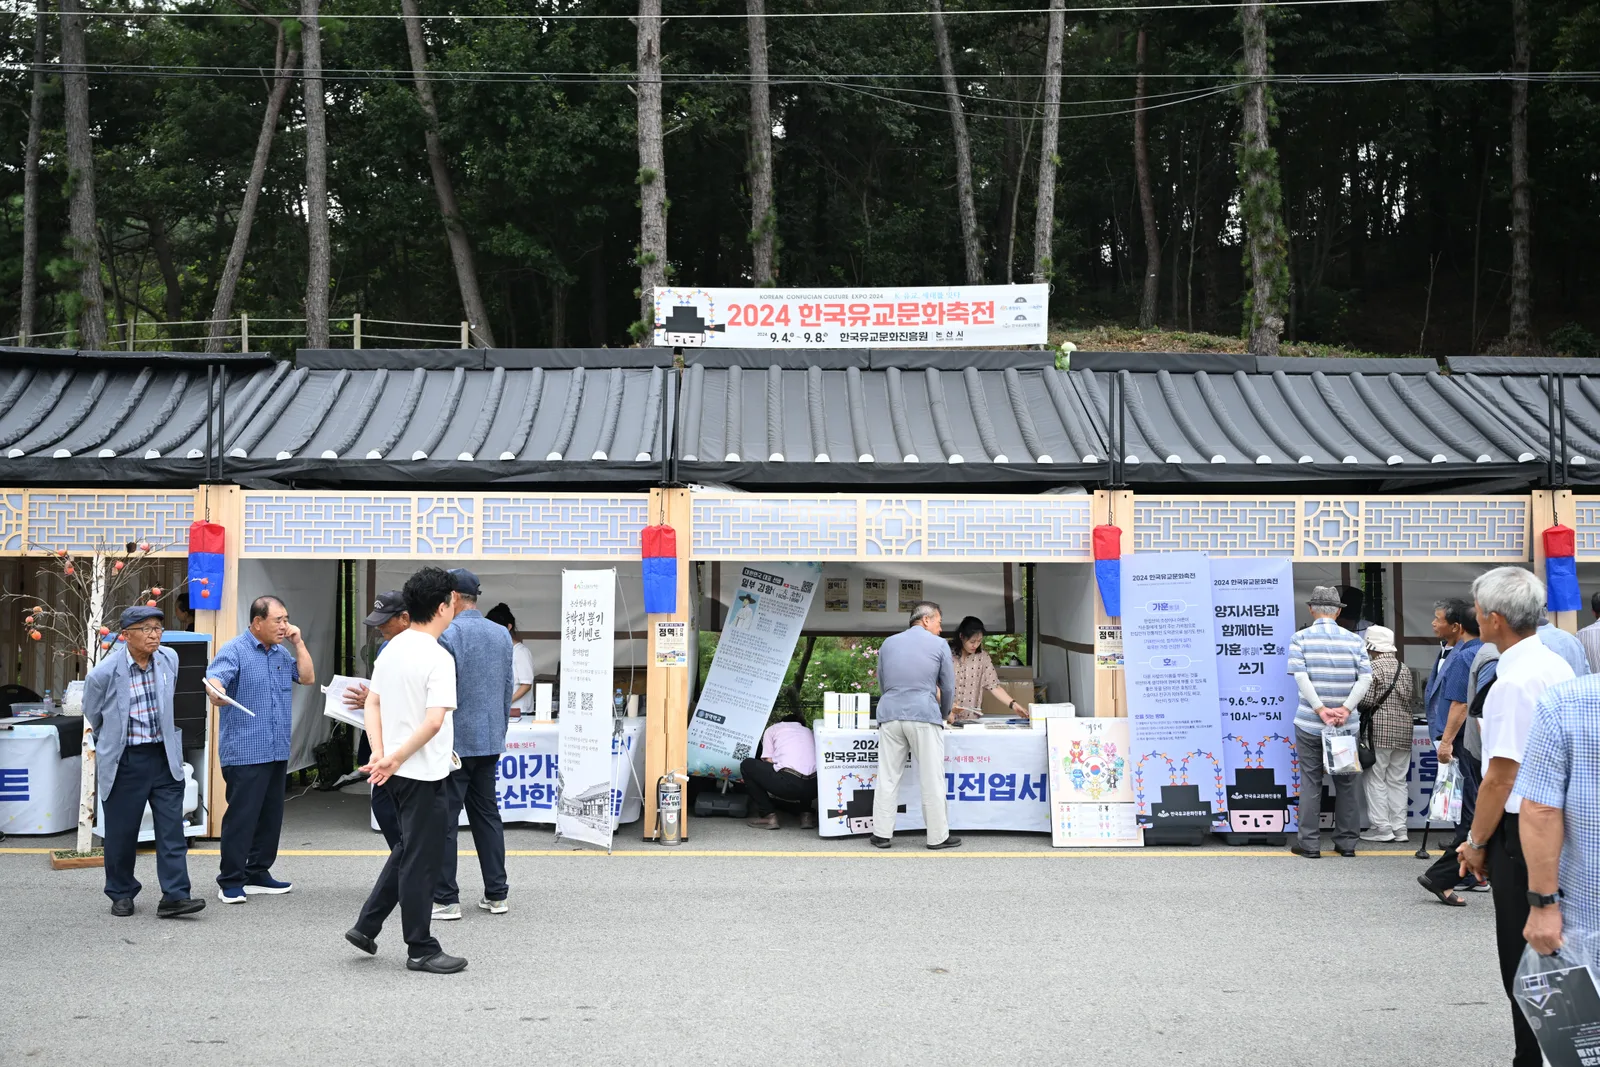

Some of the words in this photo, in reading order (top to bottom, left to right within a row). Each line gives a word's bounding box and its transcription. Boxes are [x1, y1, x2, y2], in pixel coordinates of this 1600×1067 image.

[728, 304, 791, 327] 2024
[798, 301, 994, 327] 한국유교문화축전
[840, 332, 928, 342] 한국유교문화진흥원
[1214, 604, 1279, 618] 양지서당과
[587, 611, 603, 626] 뽑기
[579, 628, 602, 642] 이벤트
[659, 628, 674, 637] 정역
[1100, 631, 1114, 639] 정역
[1221, 624, 1273, 636] 함께하는
[1238, 662, 1264, 674] 쓰기
[1261, 696, 1284, 705] 9.7.
[1266, 712, 1282, 720] 5시
[496, 754, 558, 780] 아가
[0, 768, 29, 801] 트
[496, 783, 558, 810] 산한
